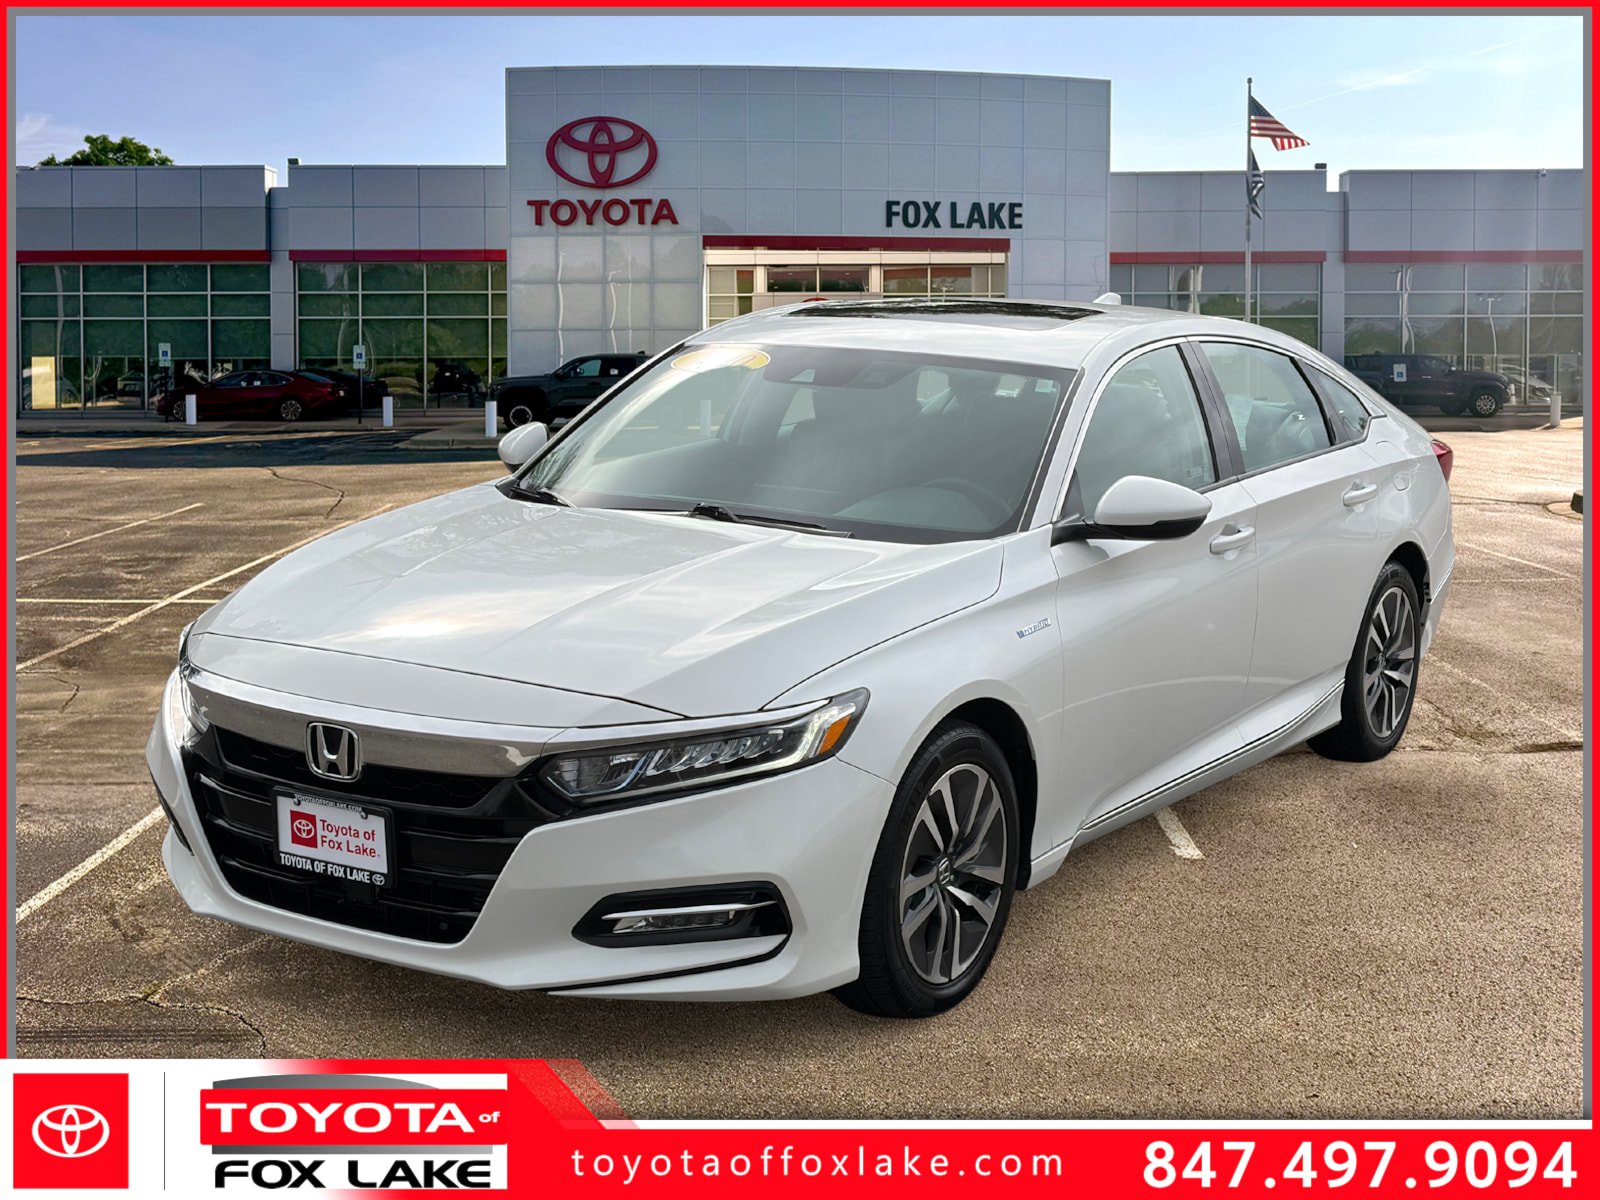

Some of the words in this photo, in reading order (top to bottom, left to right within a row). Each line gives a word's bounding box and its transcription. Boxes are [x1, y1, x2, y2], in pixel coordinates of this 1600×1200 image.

[527, 199, 679, 226] TOYOTA
[885, 200, 942, 229] FOX
[950, 201, 1023, 230] LAKE
[320, 819, 360, 838] Toyota
[363, 829, 376, 842] of
[320, 835, 343, 852] Fox
[346, 839, 376, 858] Lake
[280, 853, 312, 871] TOYOTA
[314, 861, 325, 874] OF
[327, 864, 345, 878] FOX
[346, 868, 371, 884] LAKE
